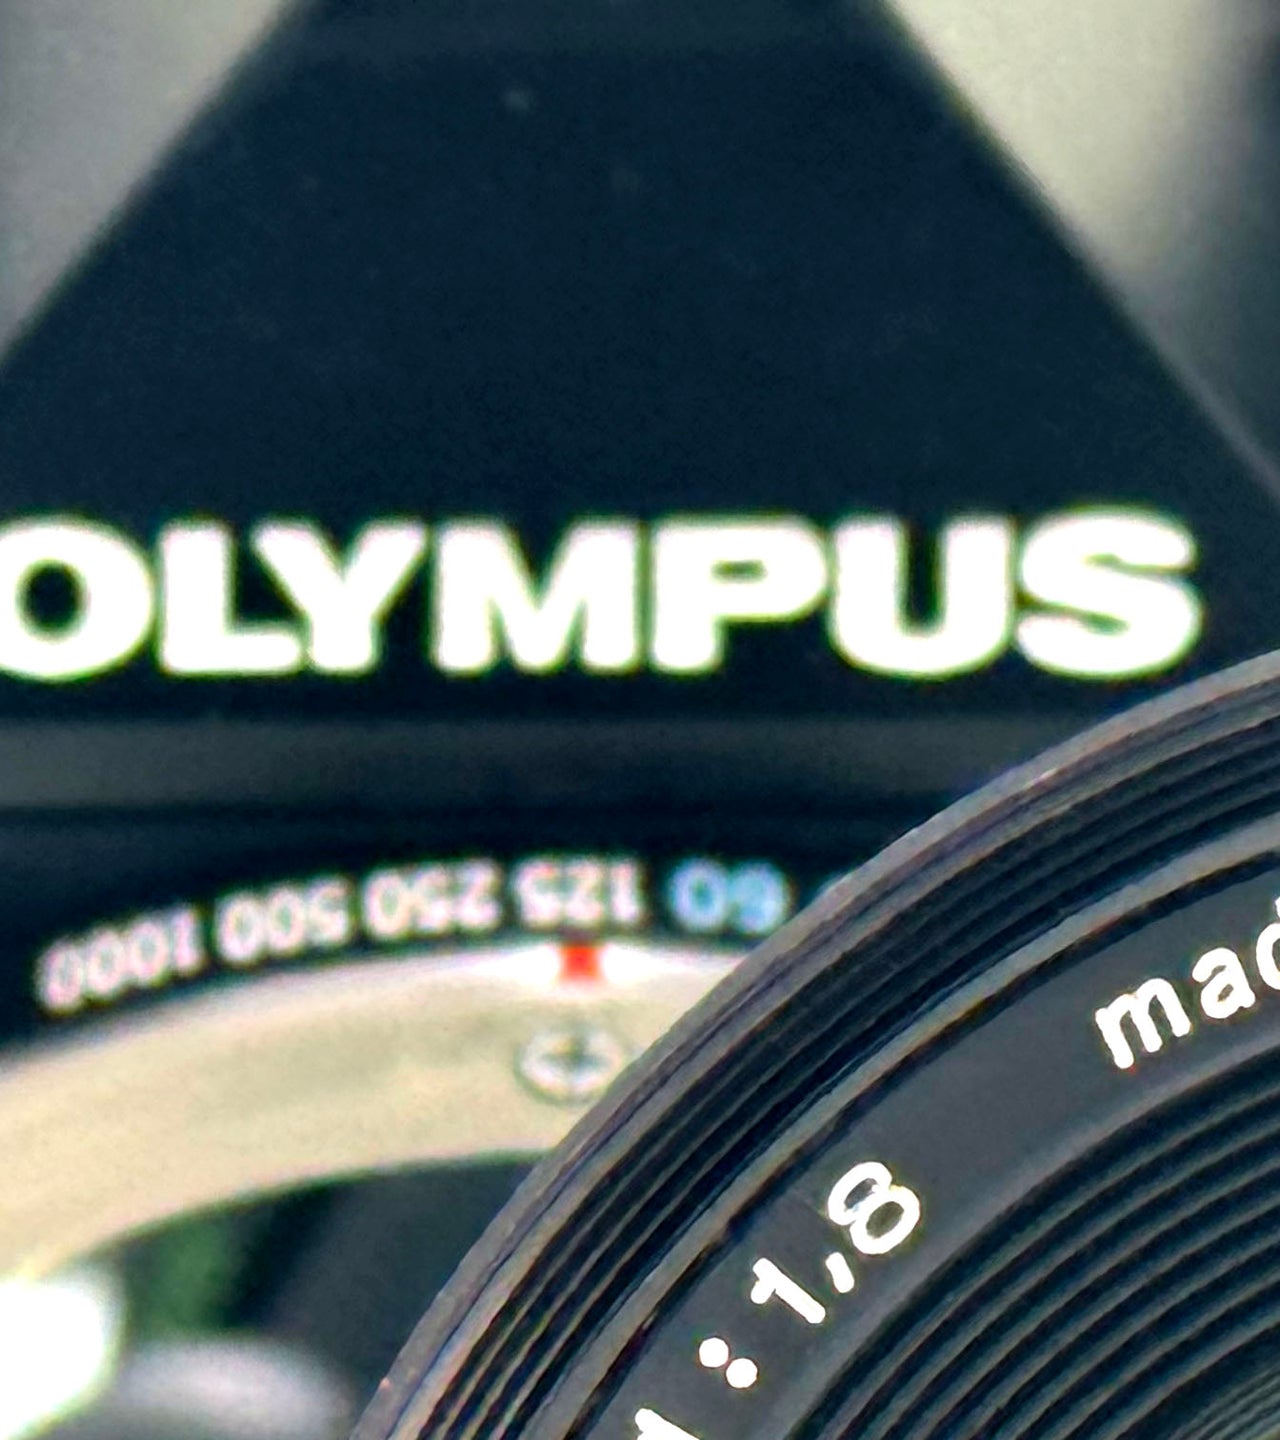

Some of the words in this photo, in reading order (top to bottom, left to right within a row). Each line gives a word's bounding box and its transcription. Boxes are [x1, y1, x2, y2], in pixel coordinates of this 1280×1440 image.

[214, 875, 356, 968] 500
[362, 857, 502, 942] 250
[512, 857, 646, 928] 125
[667, 858, 792, 935] 60
[36, 906, 205, 1014] 1000
